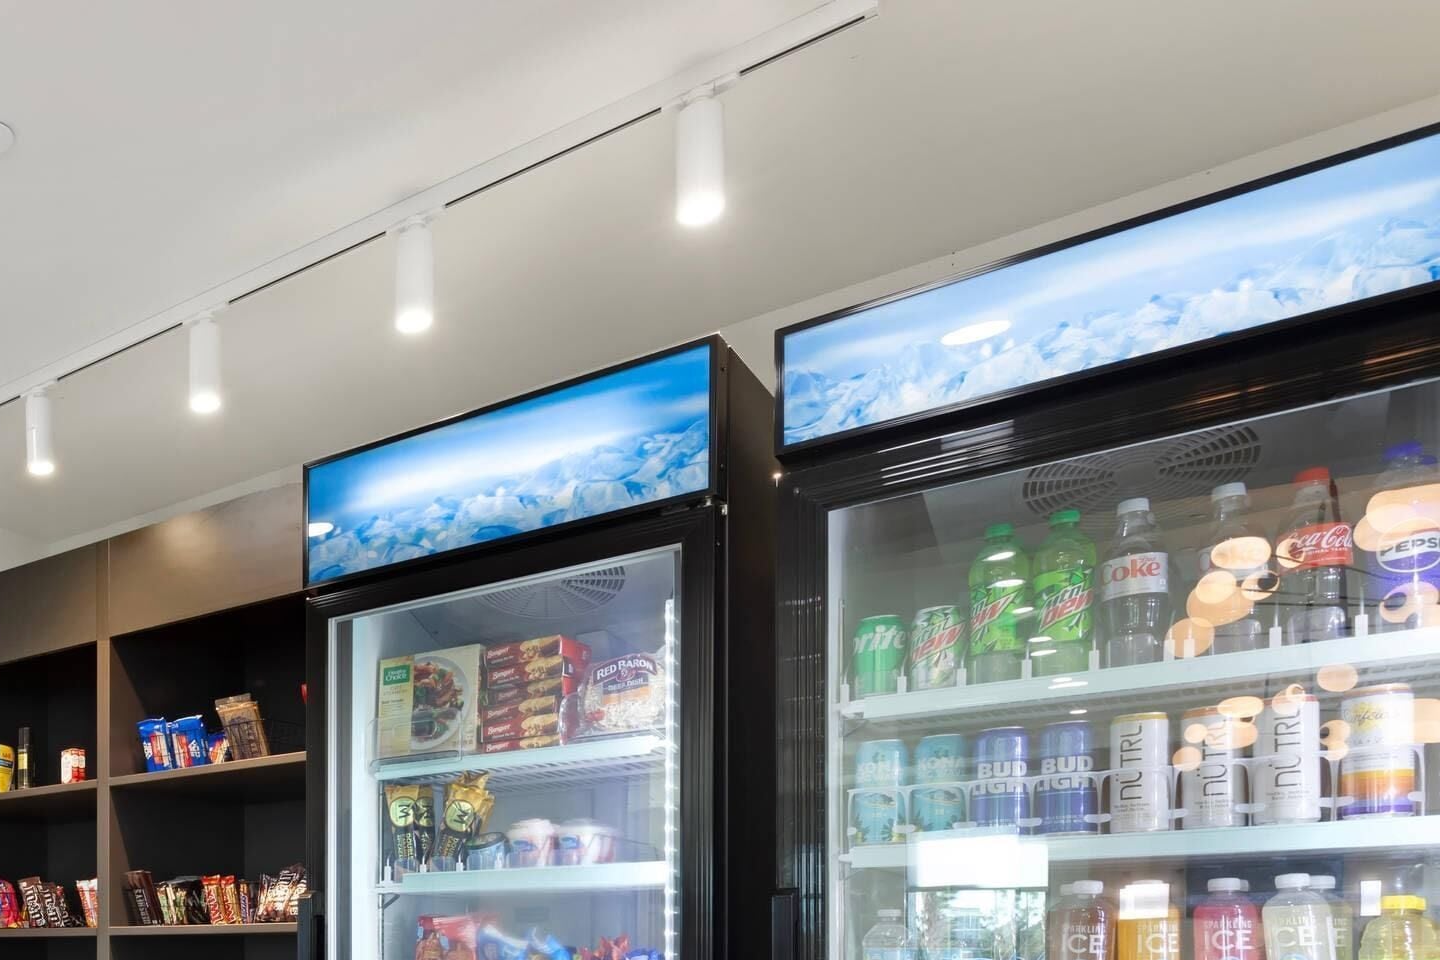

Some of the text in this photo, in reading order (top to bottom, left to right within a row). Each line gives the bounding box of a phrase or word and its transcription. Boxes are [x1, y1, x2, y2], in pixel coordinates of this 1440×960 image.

[1101, 558, 1161, 586] Coke
[596, 659, 655, 681] RED BARON
[627, 679, 644, 687] DISH
[977, 761, 1027, 779] BUD
[1041, 755, 1094, 774] BUD
[1137, 933, 1180, 954] ICE
[1204, 929, 1256, 951] ICE
